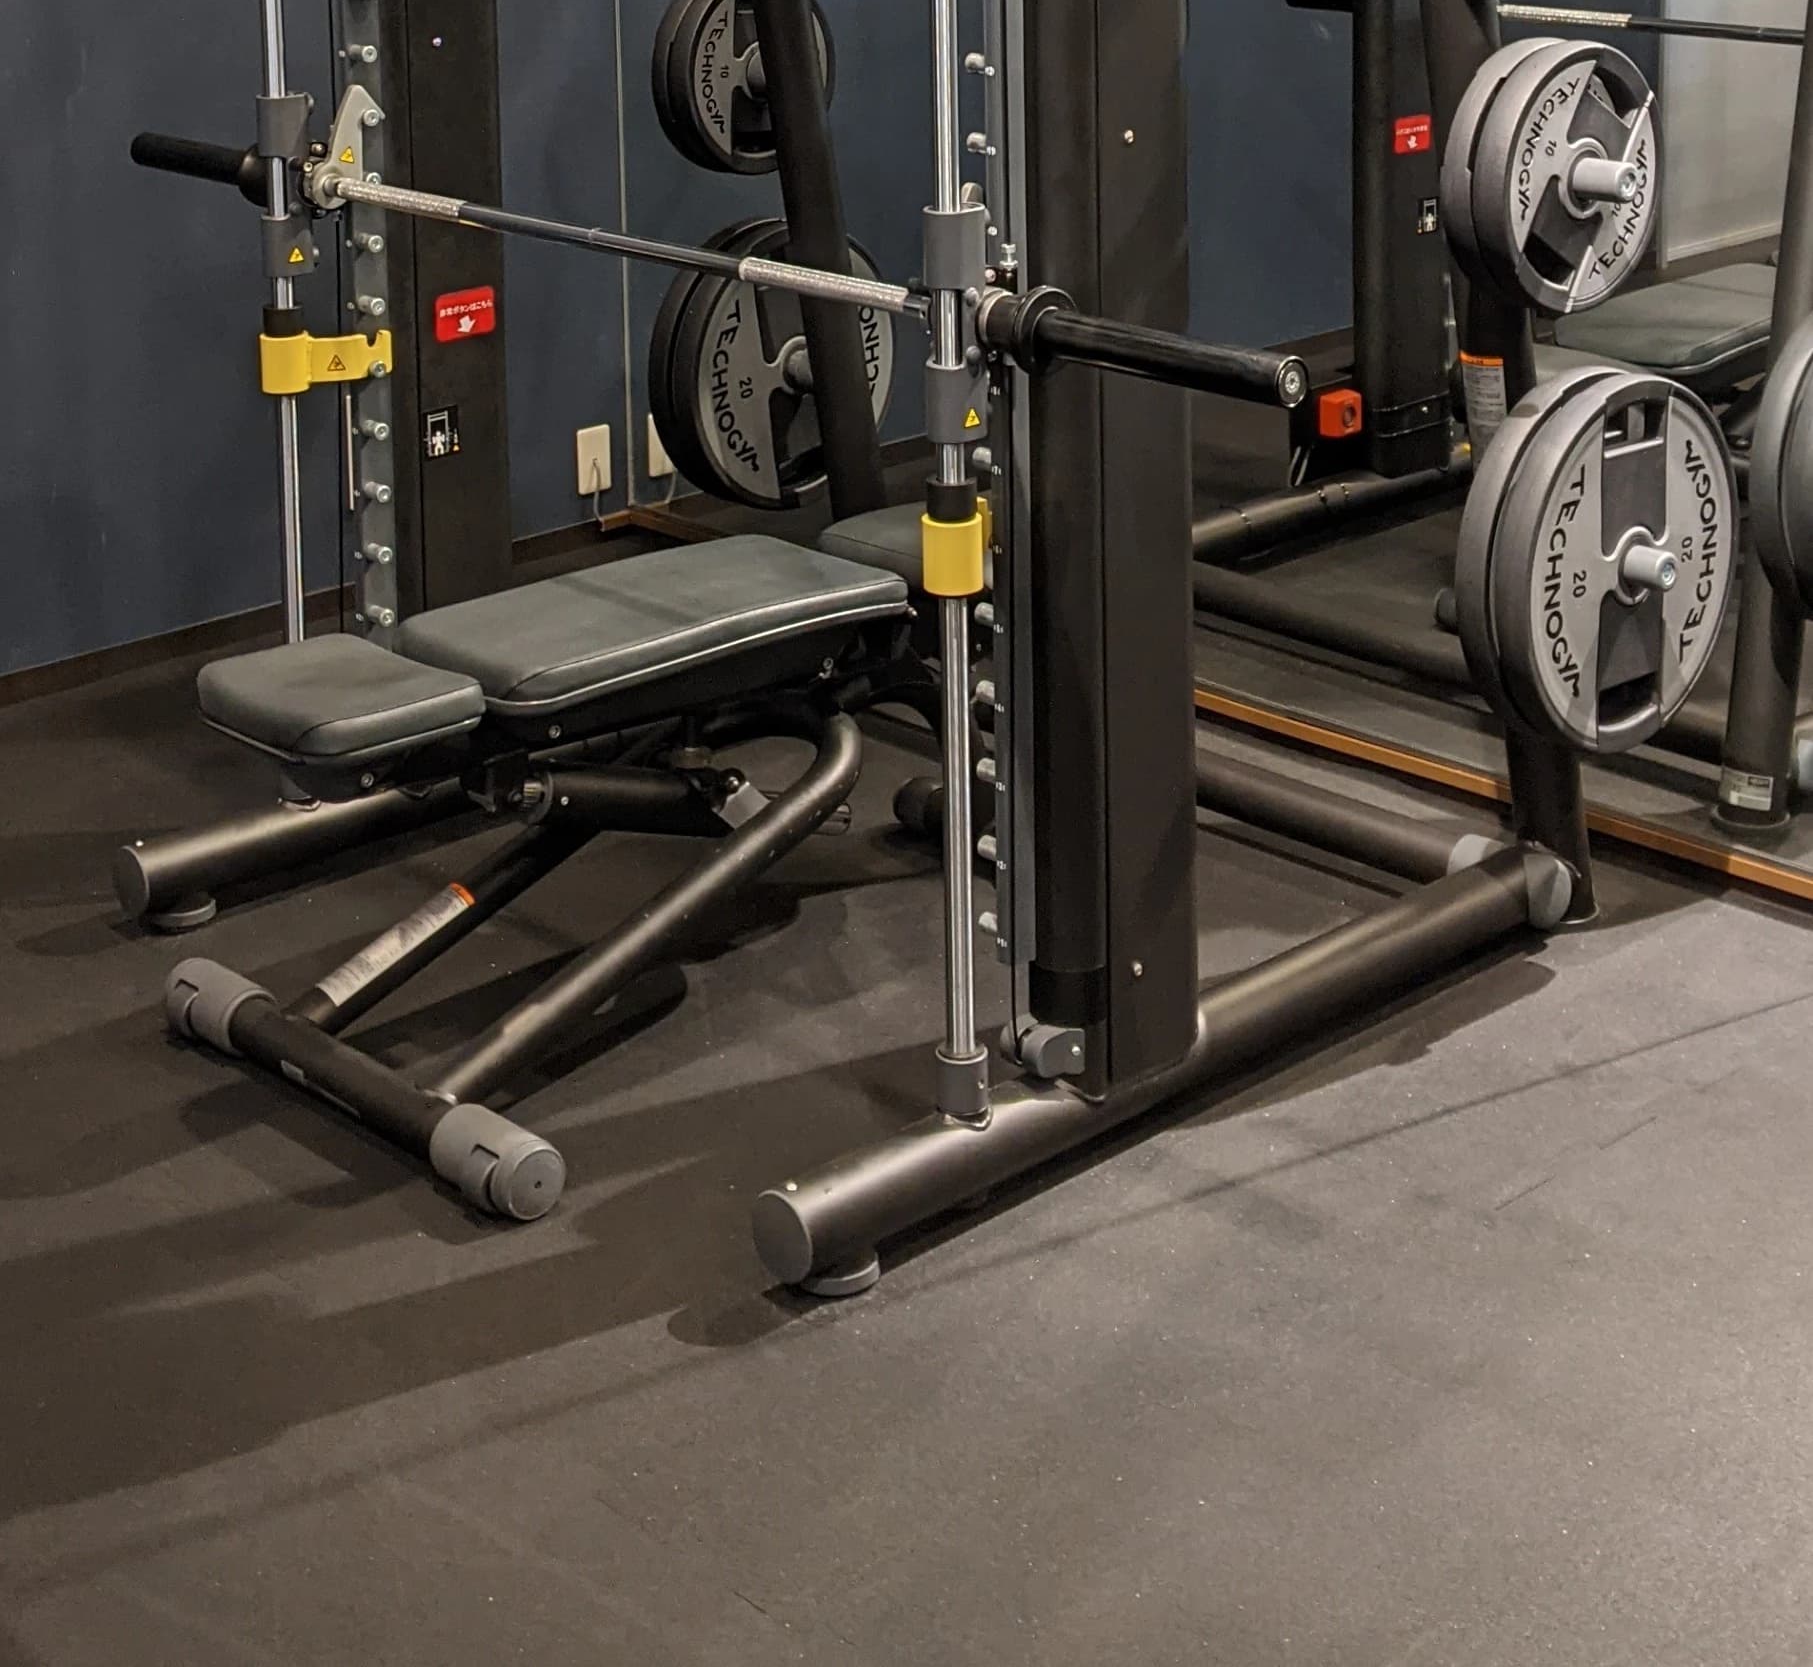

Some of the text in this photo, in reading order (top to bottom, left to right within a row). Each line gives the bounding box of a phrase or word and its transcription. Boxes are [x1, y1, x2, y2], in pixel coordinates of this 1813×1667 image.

[701, 11, 728, 135] TECHNOGYM
[720, 65, 729, 78] 10
[1517, 77, 1581, 220] TECHNOGYM
[1546, 140, 1557, 157] 10
[1611, 202, 1622, 218] 10
[711, 300, 760, 472] TECHNOGYM
[739, 378, 752, 399] 20
[1678, 439, 1717, 664] TECHNOGYM
[1681, 535, 1693, 563] 20
[1542, 465, 1585, 698] TECHNOGYM
[1571, 570, 1586, 599] 20
